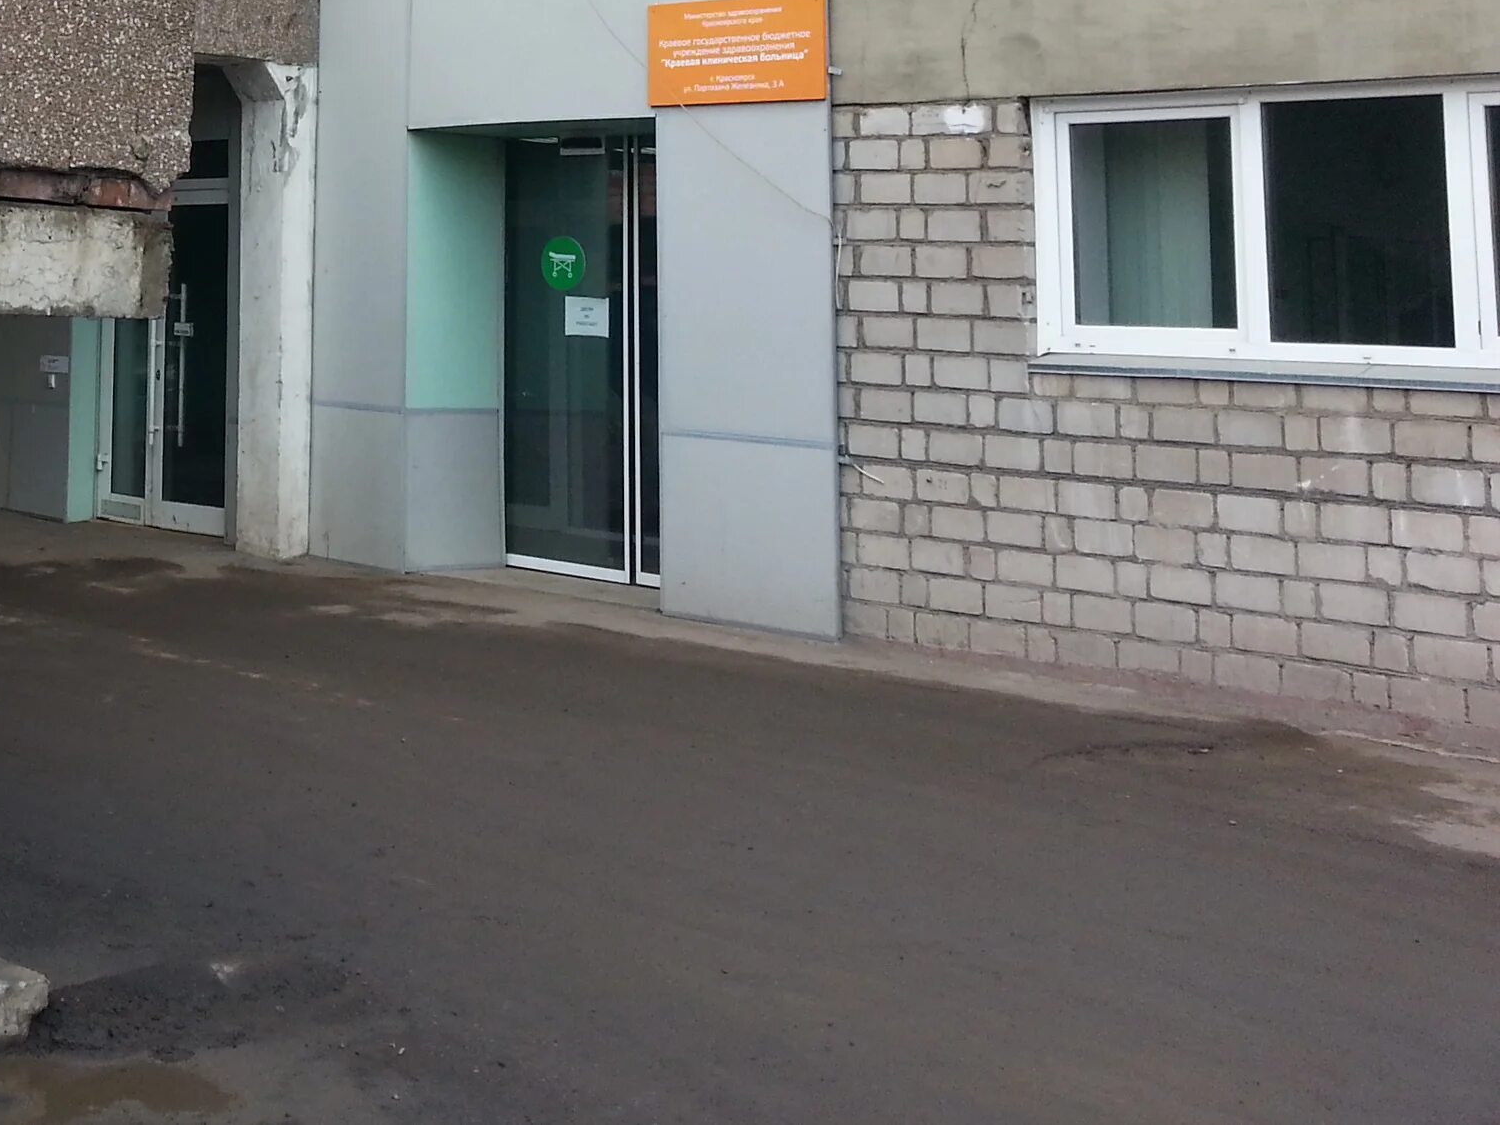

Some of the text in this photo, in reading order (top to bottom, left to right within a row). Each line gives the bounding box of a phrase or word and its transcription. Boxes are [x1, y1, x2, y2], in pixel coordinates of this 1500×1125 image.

[659, 31, 811, 50] Краевое государственное бюджетное
[673, 43, 795, 59] учреждение здравоохранения
[701, 54, 759, 66] клиническая
